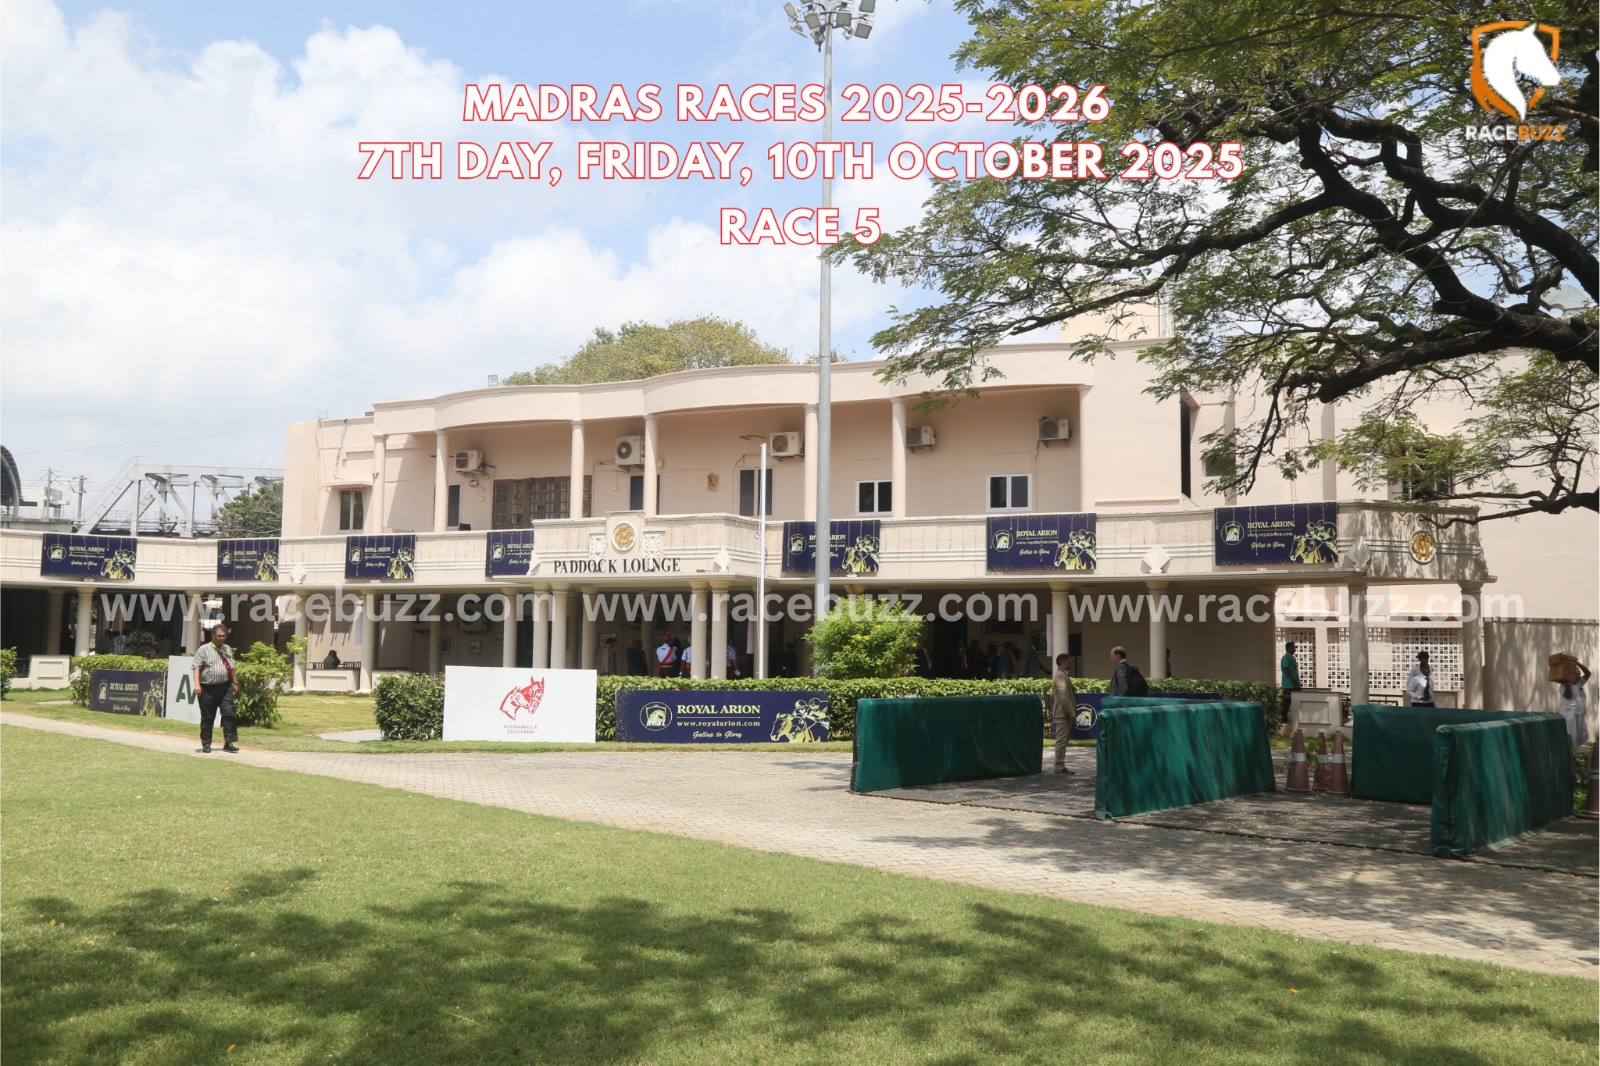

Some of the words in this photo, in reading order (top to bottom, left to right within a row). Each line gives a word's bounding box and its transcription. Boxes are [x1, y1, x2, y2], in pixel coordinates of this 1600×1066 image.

[1271, 520, 1294, 528] ARION
[554, 559, 618, 574] PADDOCK
[623, 557, 681, 573] LOUNGE
[677, 705, 718, 714] ROYAL
[720, 705, 761, 714] ARION
[677, 720, 761, 728] www.royalarion.com
[692, 730, 714, 739] Gallop
[724, 730, 742, 739] Glory
